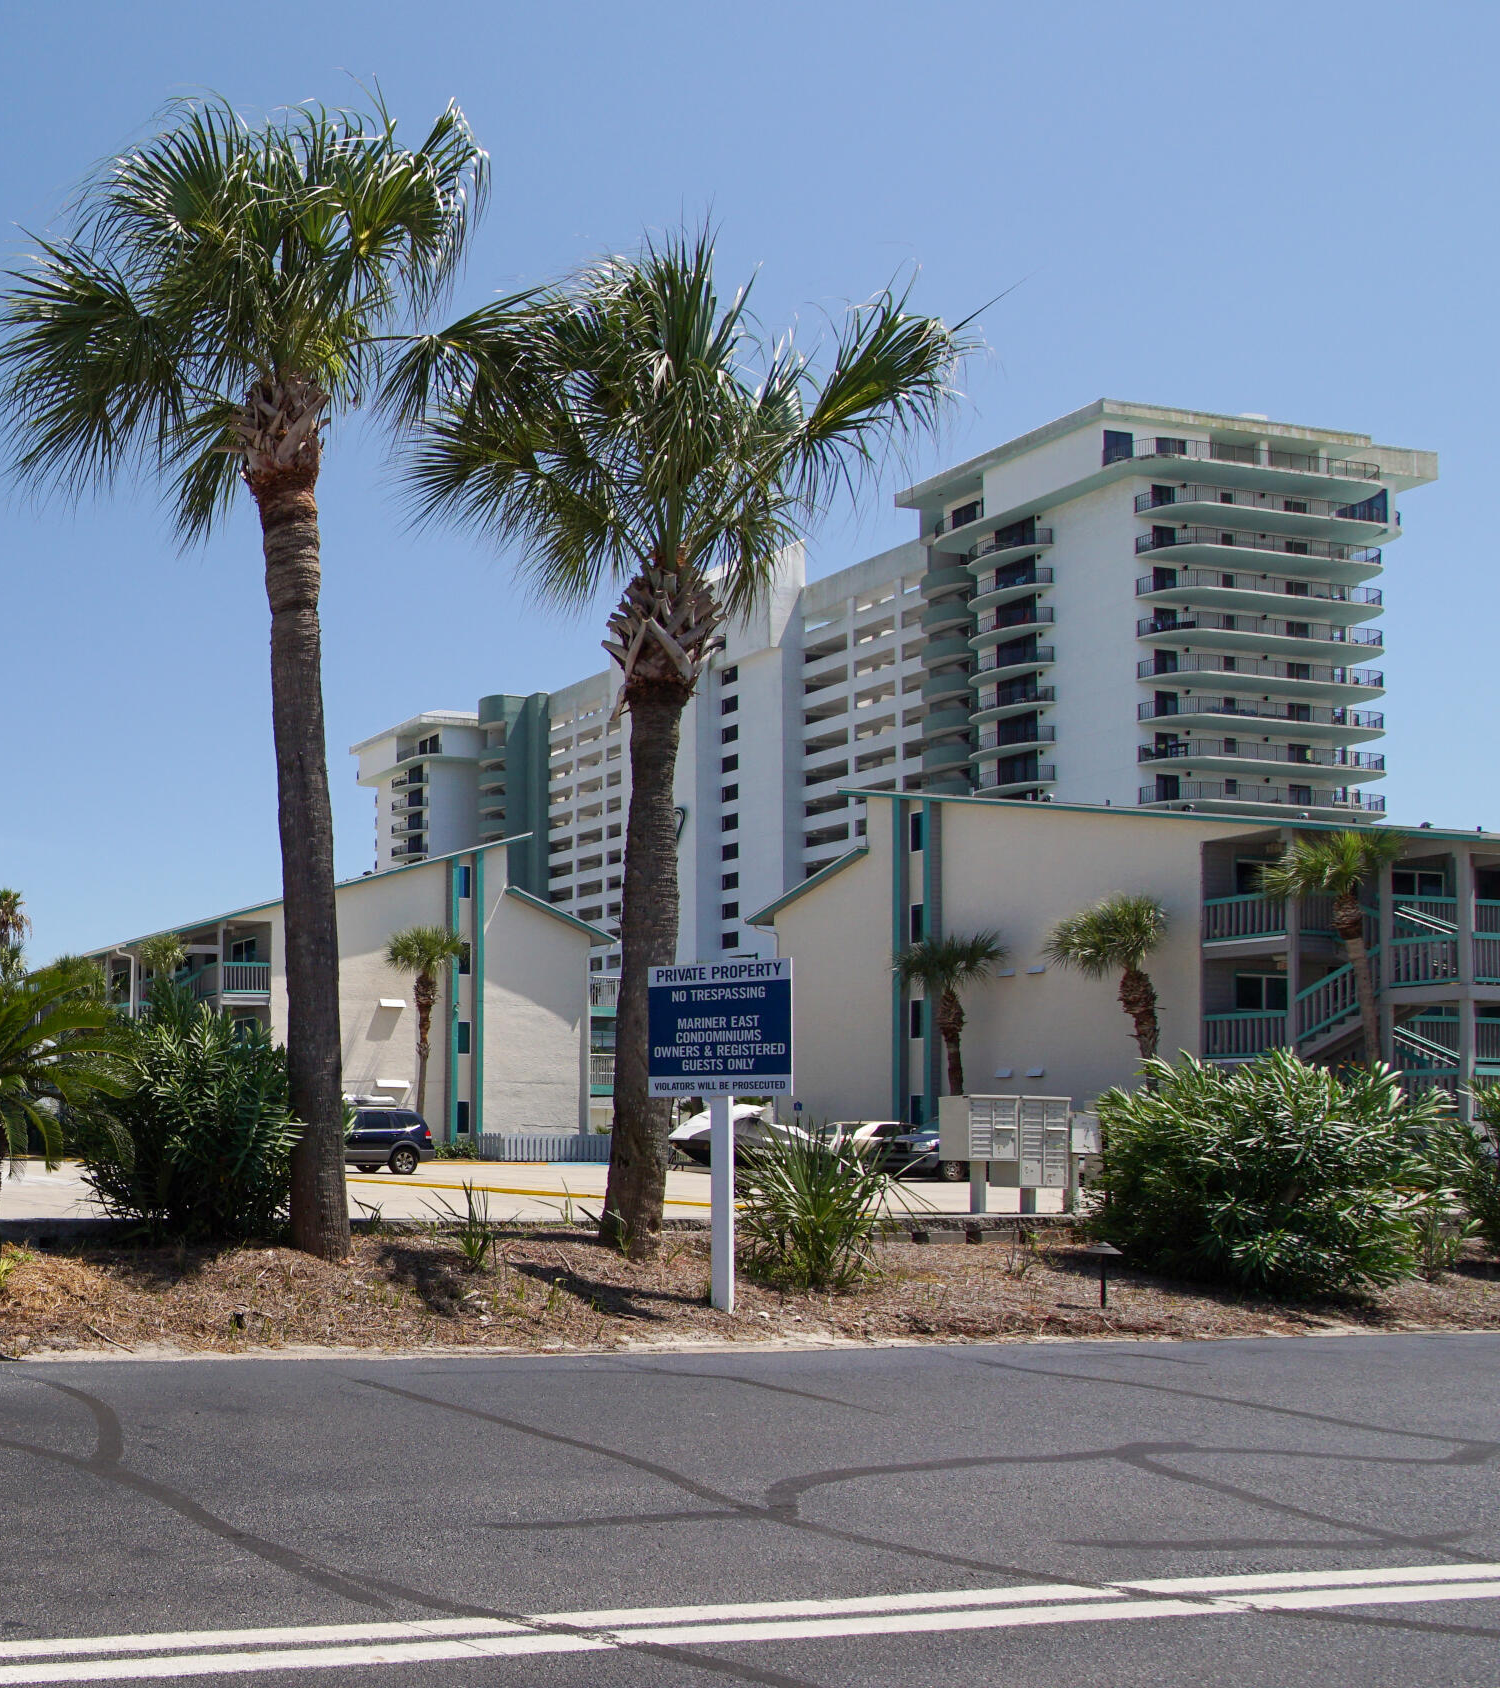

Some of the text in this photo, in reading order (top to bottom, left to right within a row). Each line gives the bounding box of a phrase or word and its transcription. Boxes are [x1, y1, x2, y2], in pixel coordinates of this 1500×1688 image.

[656, 962, 782, 983] PRIVATE PROPERTY
[671, 986, 766, 1003] NO TRESPASSING
[677, 1015, 760, 1030] MARINER EAST
[676, 1029, 762, 1044] CONDOMINIUMS
[654, 1042, 786, 1058] OWNERS & REGISTERED
[682, 1058, 755, 1072] GUESTS ONLY
[654, 1080, 786, 1091] VIOLATORS WILL BE PROSECUTED
